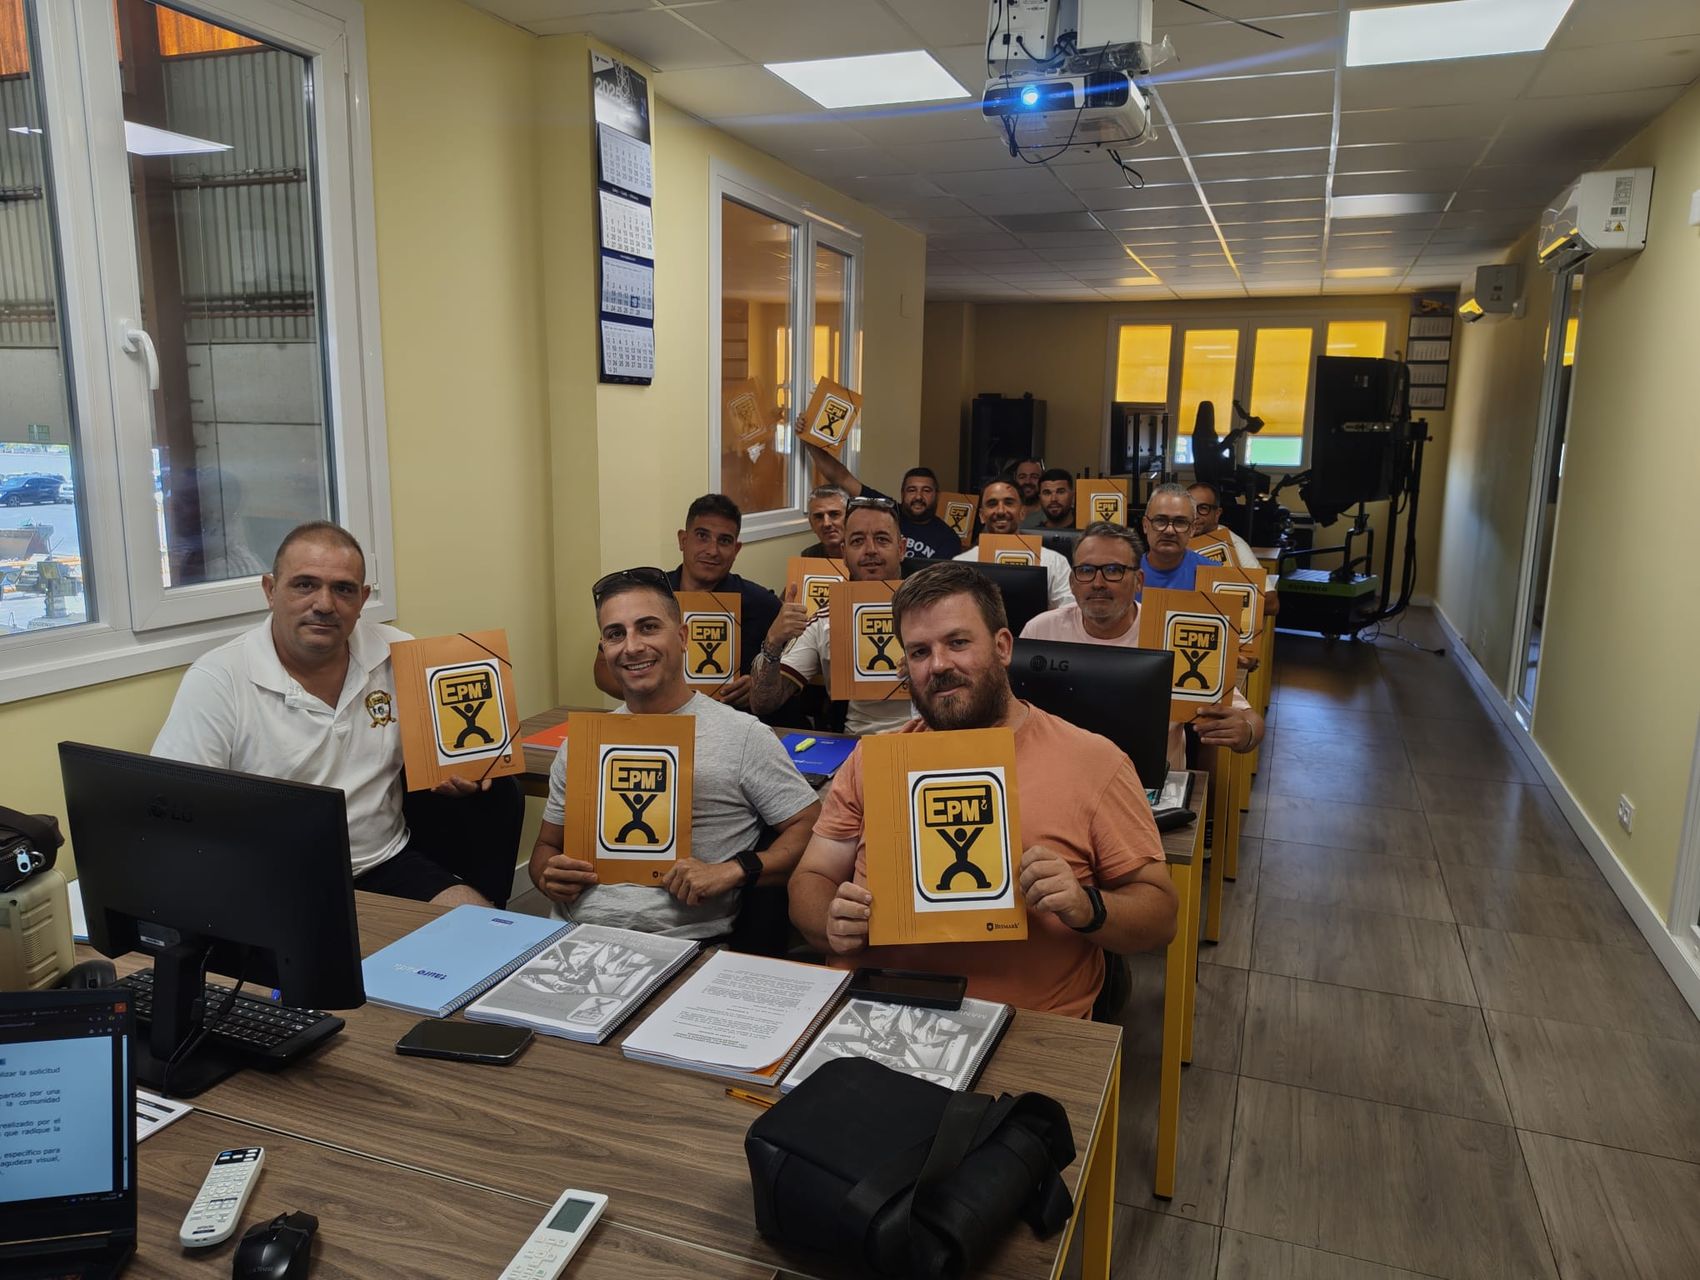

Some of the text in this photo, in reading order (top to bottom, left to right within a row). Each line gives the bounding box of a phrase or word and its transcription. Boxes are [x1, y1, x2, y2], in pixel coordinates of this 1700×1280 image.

[905, 536, 936, 559] BON
[692, 621, 724, 641] EPM
[862, 613, 893, 635] EPM
[1175, 624, 1215, 648] EPM
[1050, 659, 1070, 672] LG
[440, 673, 487, 705] EPM
[611, 760, 664, 790] EPM
[925, 786, 986, 824] EPM
